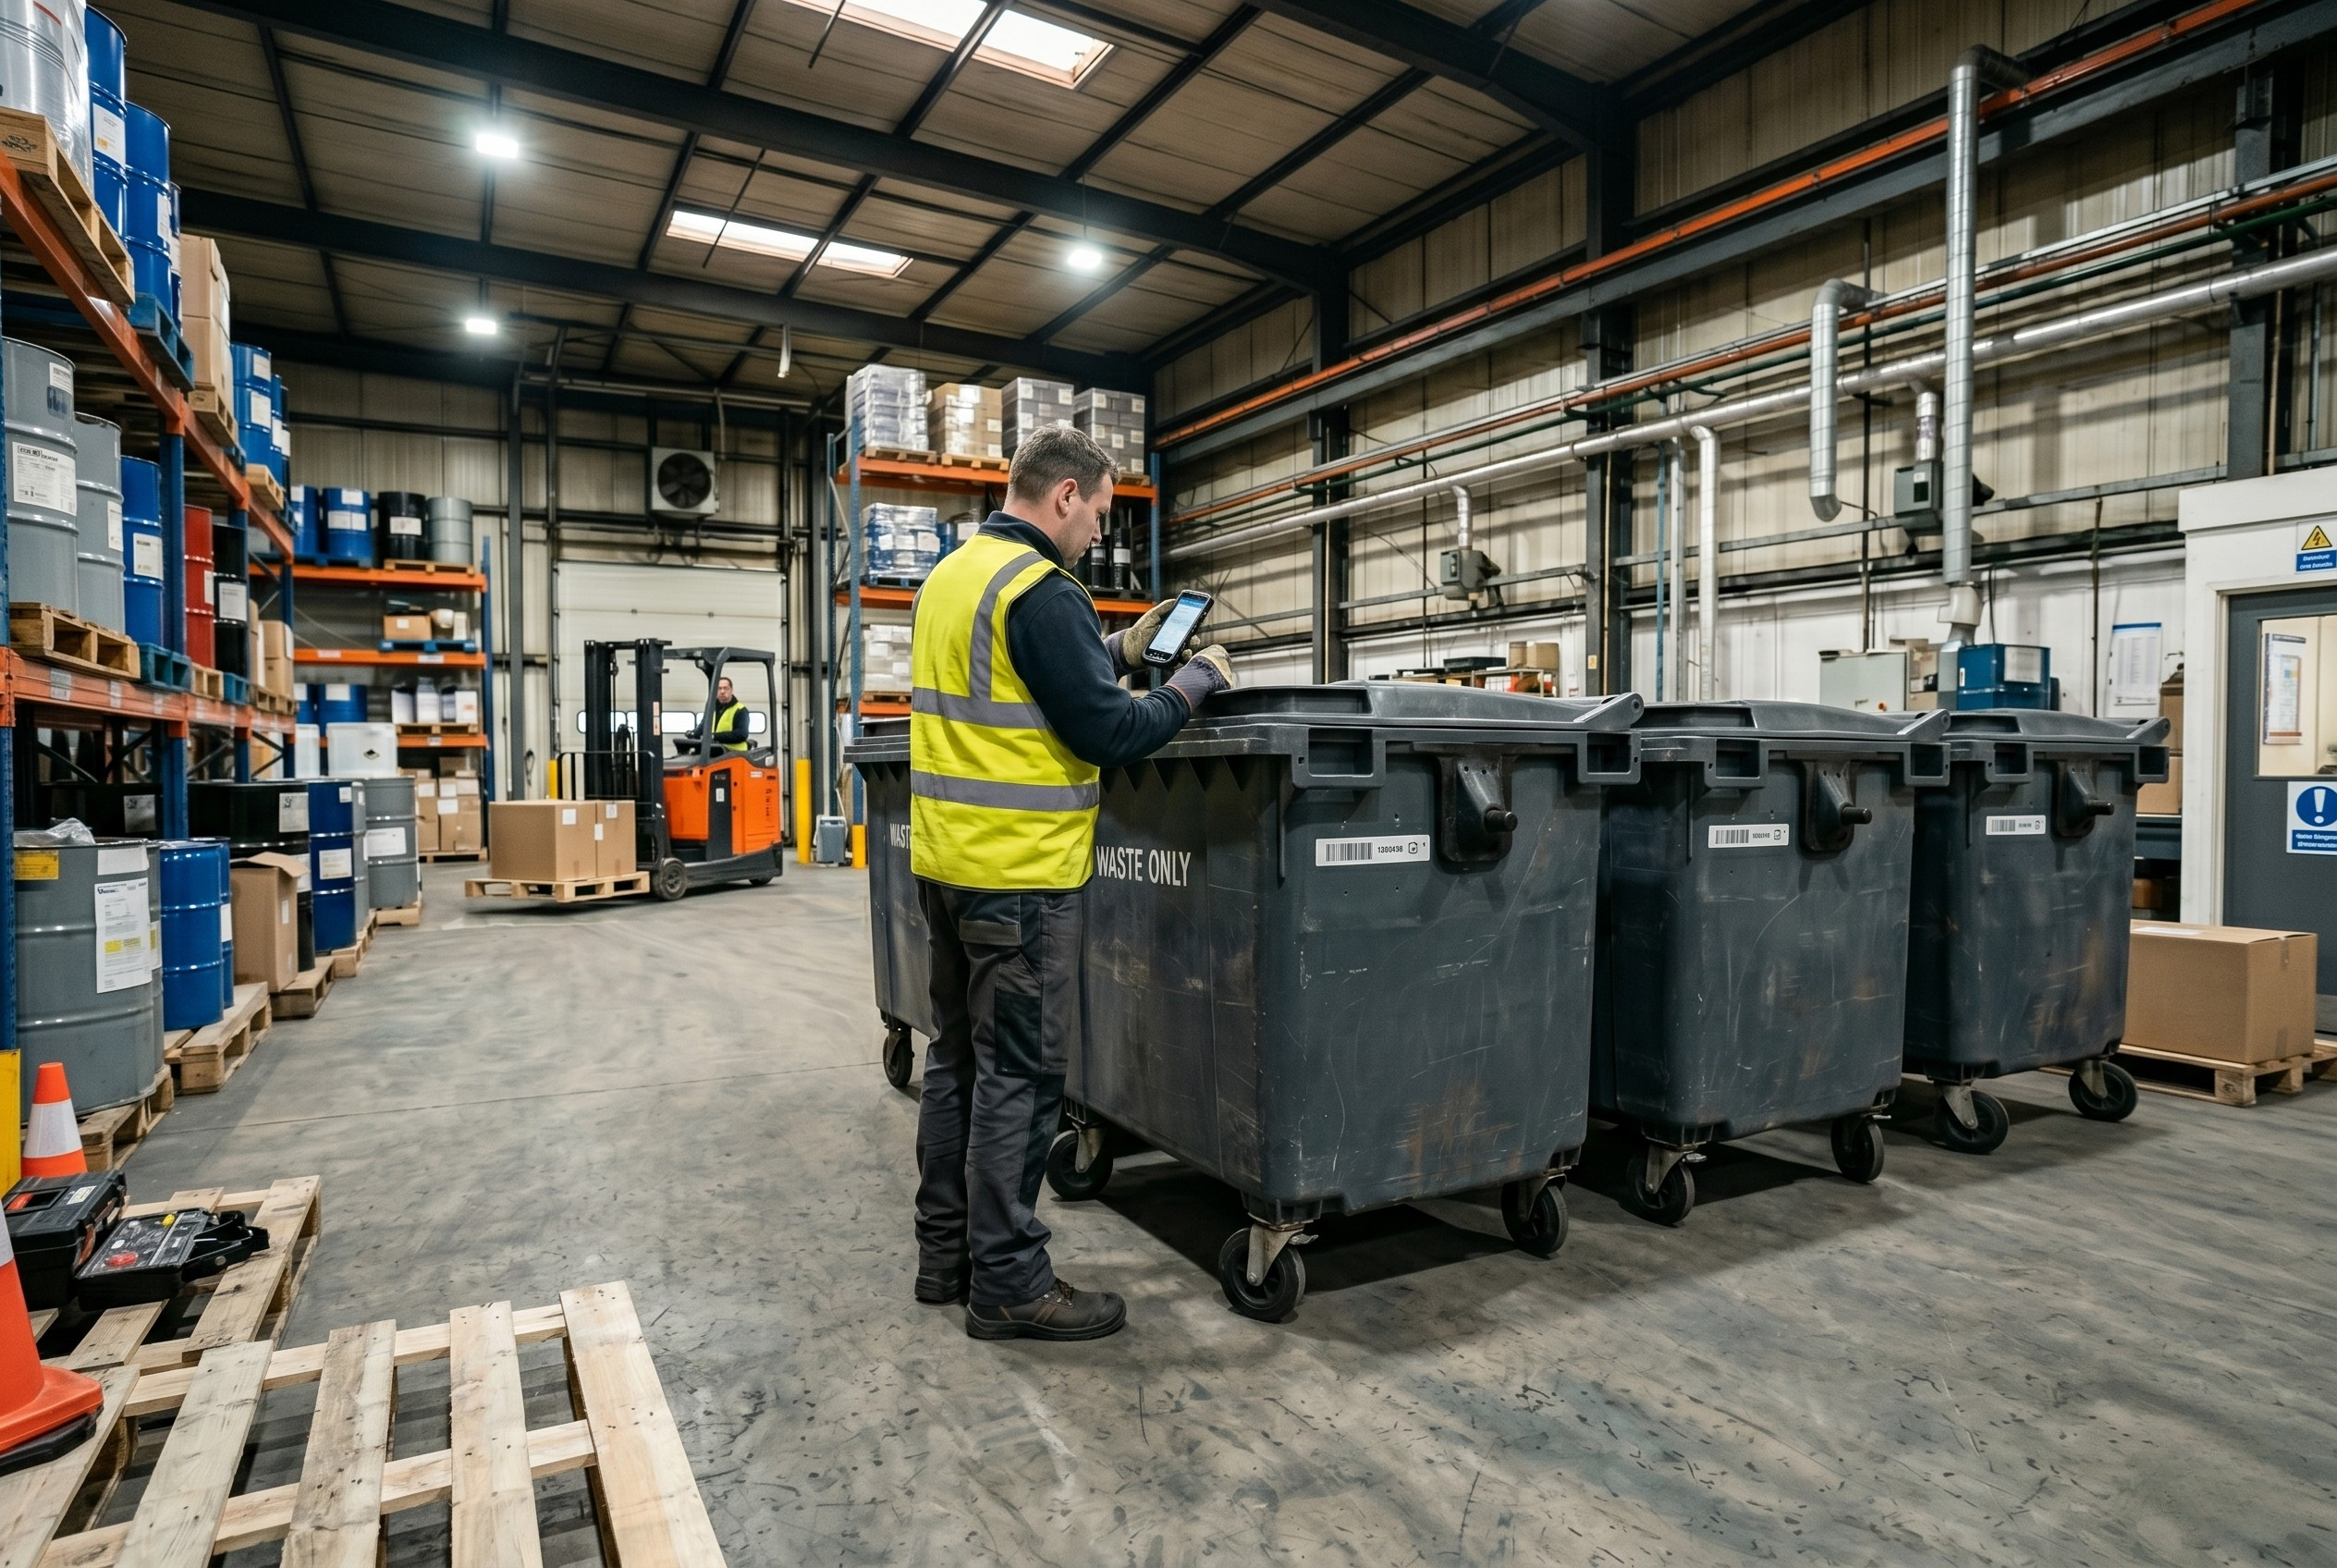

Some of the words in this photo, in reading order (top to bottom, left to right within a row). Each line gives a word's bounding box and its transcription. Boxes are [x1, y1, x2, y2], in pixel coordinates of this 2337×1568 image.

[889, 822, 912, 850] WAST
[1095, 845, 1144, 882] WASTE
[1148, 849, 1192, 887] ONLY
